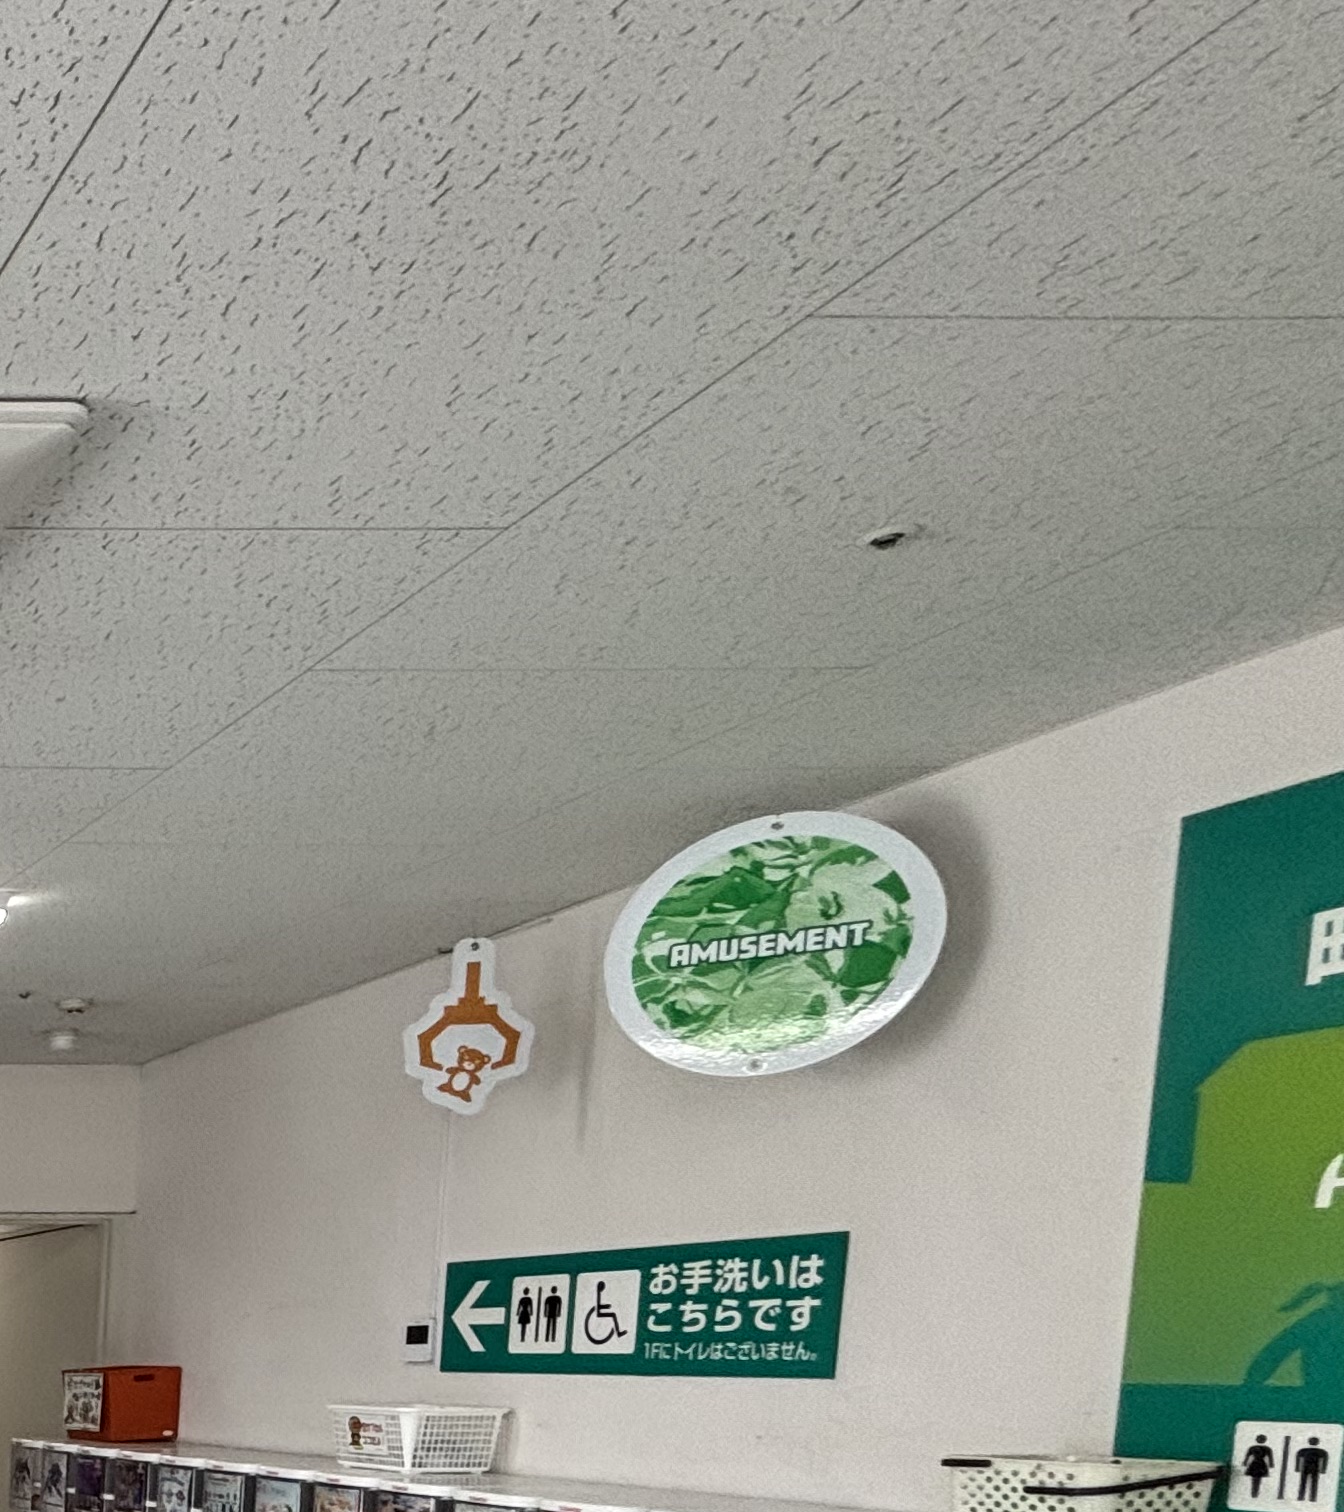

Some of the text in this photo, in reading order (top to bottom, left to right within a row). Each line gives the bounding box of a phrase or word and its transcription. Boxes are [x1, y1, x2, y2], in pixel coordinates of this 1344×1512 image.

[667, 920, 873, 969] AMUSEMENT
[647, 1255, 824, 1297] お手洗いは
[647, 1299, 821, 1334] こちらです
[644, 1340, 817, 1363] 1Fにトイレはございません。
